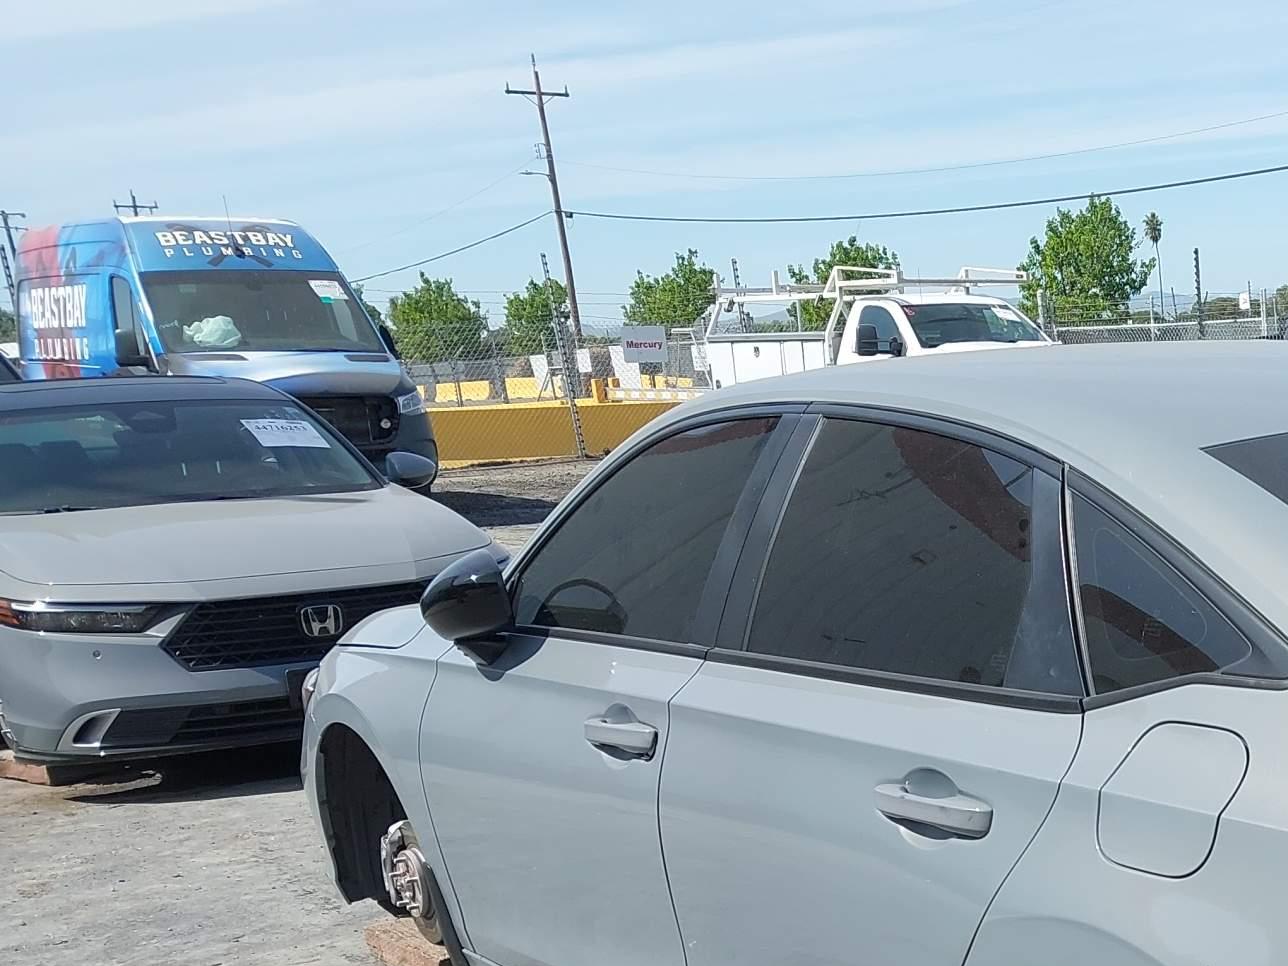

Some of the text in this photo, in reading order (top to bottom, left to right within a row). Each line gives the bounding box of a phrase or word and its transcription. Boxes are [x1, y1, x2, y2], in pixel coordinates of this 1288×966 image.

[155, 231, 294, 247] BEASTBAY
[164, 248, 303, 259] PLUMBING
[31, 284, 86, 329] BEASTBAY
[34, 337, 89, 360] PLUMBING
[626, 340, 663, 350] Mercury
